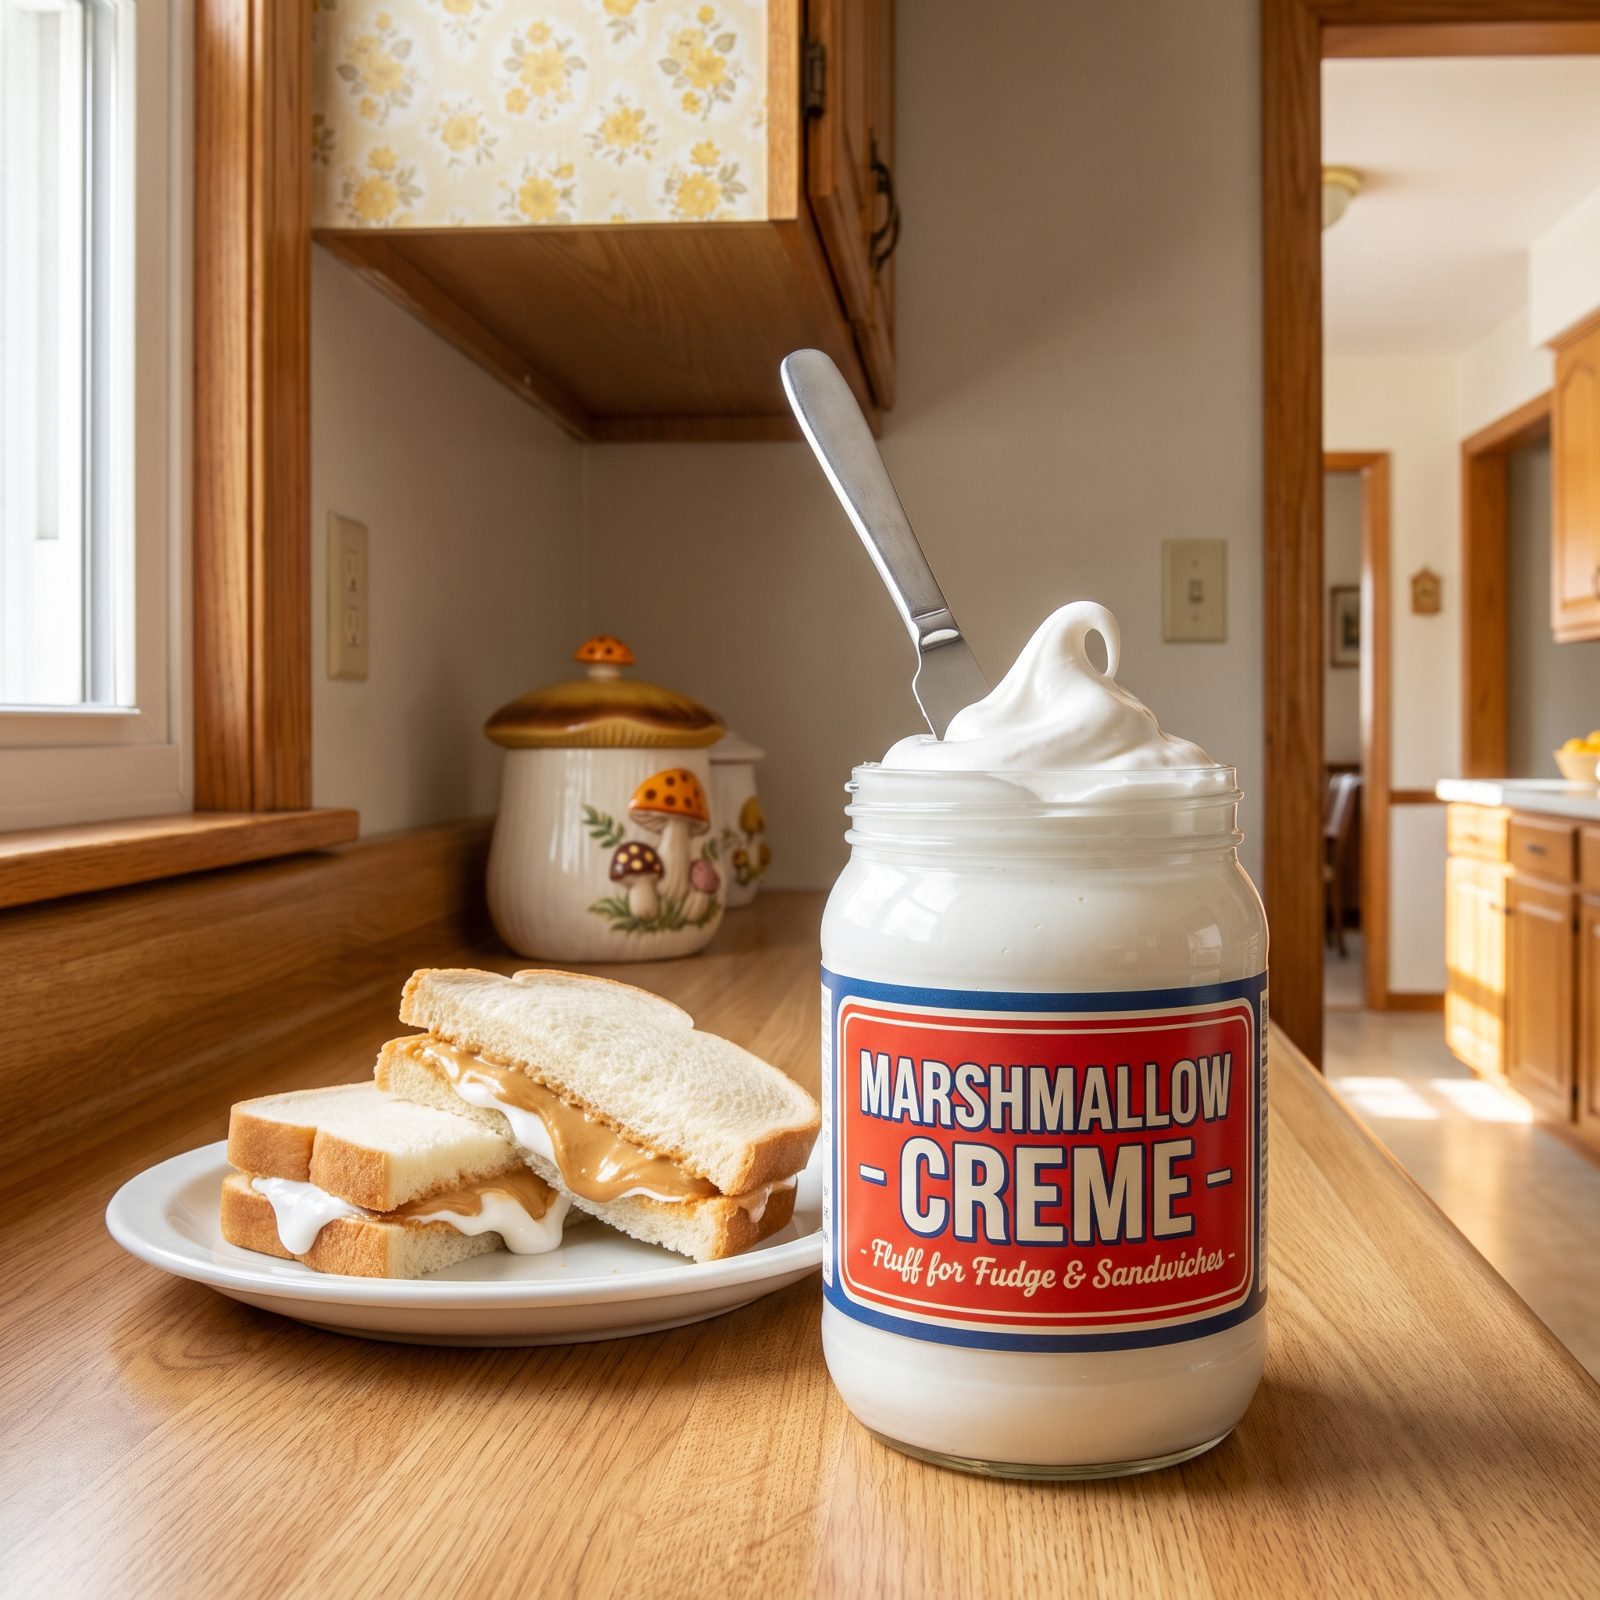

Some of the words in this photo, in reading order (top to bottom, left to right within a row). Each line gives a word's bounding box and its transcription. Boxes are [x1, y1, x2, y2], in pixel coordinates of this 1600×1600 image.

[860, 1048, 1232, 1133] MARSHMALLOW
[899, 1136, 1195, 1246] CREME
[871, 1239, 925, 1286] Fluff
[926, 1251, 965, 1288] for
[972, 1256, 1057, 1297] Fudge
[1063, 1260, 1086, 1288] &
[1092, 1247, 1225, 1288] Sandwiches
